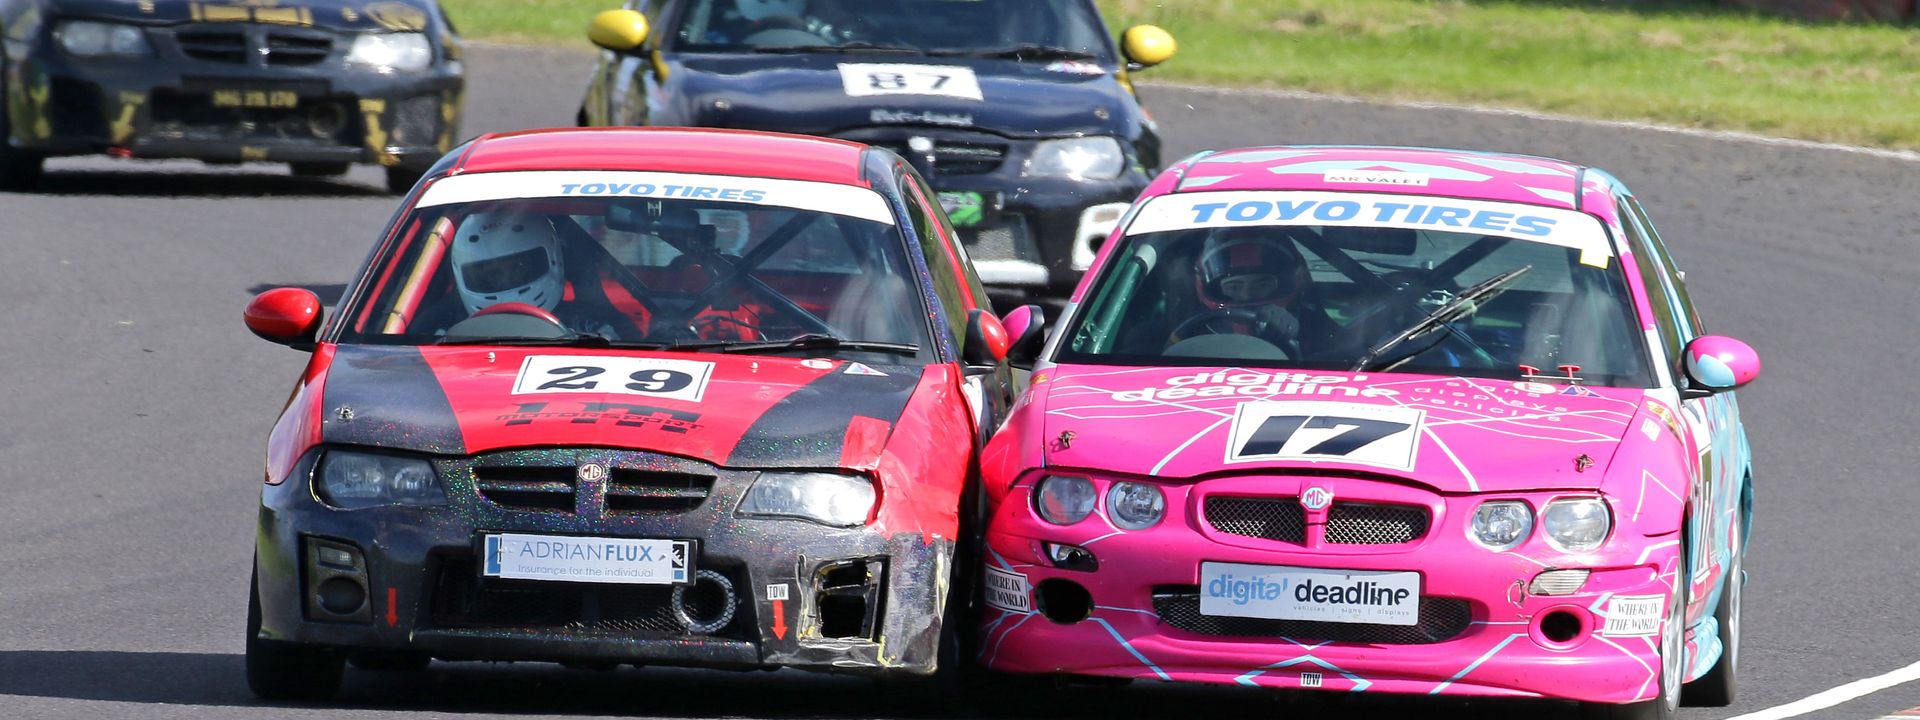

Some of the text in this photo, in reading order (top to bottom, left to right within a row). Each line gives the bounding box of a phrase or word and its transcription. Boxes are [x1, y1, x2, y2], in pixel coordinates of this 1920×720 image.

[867, 71, 951, 90] 87
[561, 183, 767, 202] TOYO TIRES
[1191, 201, 1558, 237] TOYO TIRES
[536, 365, 693, 393] 29
[1111, 381, 1401, 401] deadline
[1445, 381, 1541, 398] signs
[1410, 396, 1561, 422] vehicles
[1414, 387, 1568, 412] displays
[1237, 415, 1412, 457] 17
[581, 464, 602, 479] MG
[1305, 489, 1325, 506] MG
[518, 564, 654, 578] Insurance for the individual
[768, 586, 787, 598] TOW
[1294, 578, 1410, 606] deadline
[1302, 673, 1320, 686] TOW
